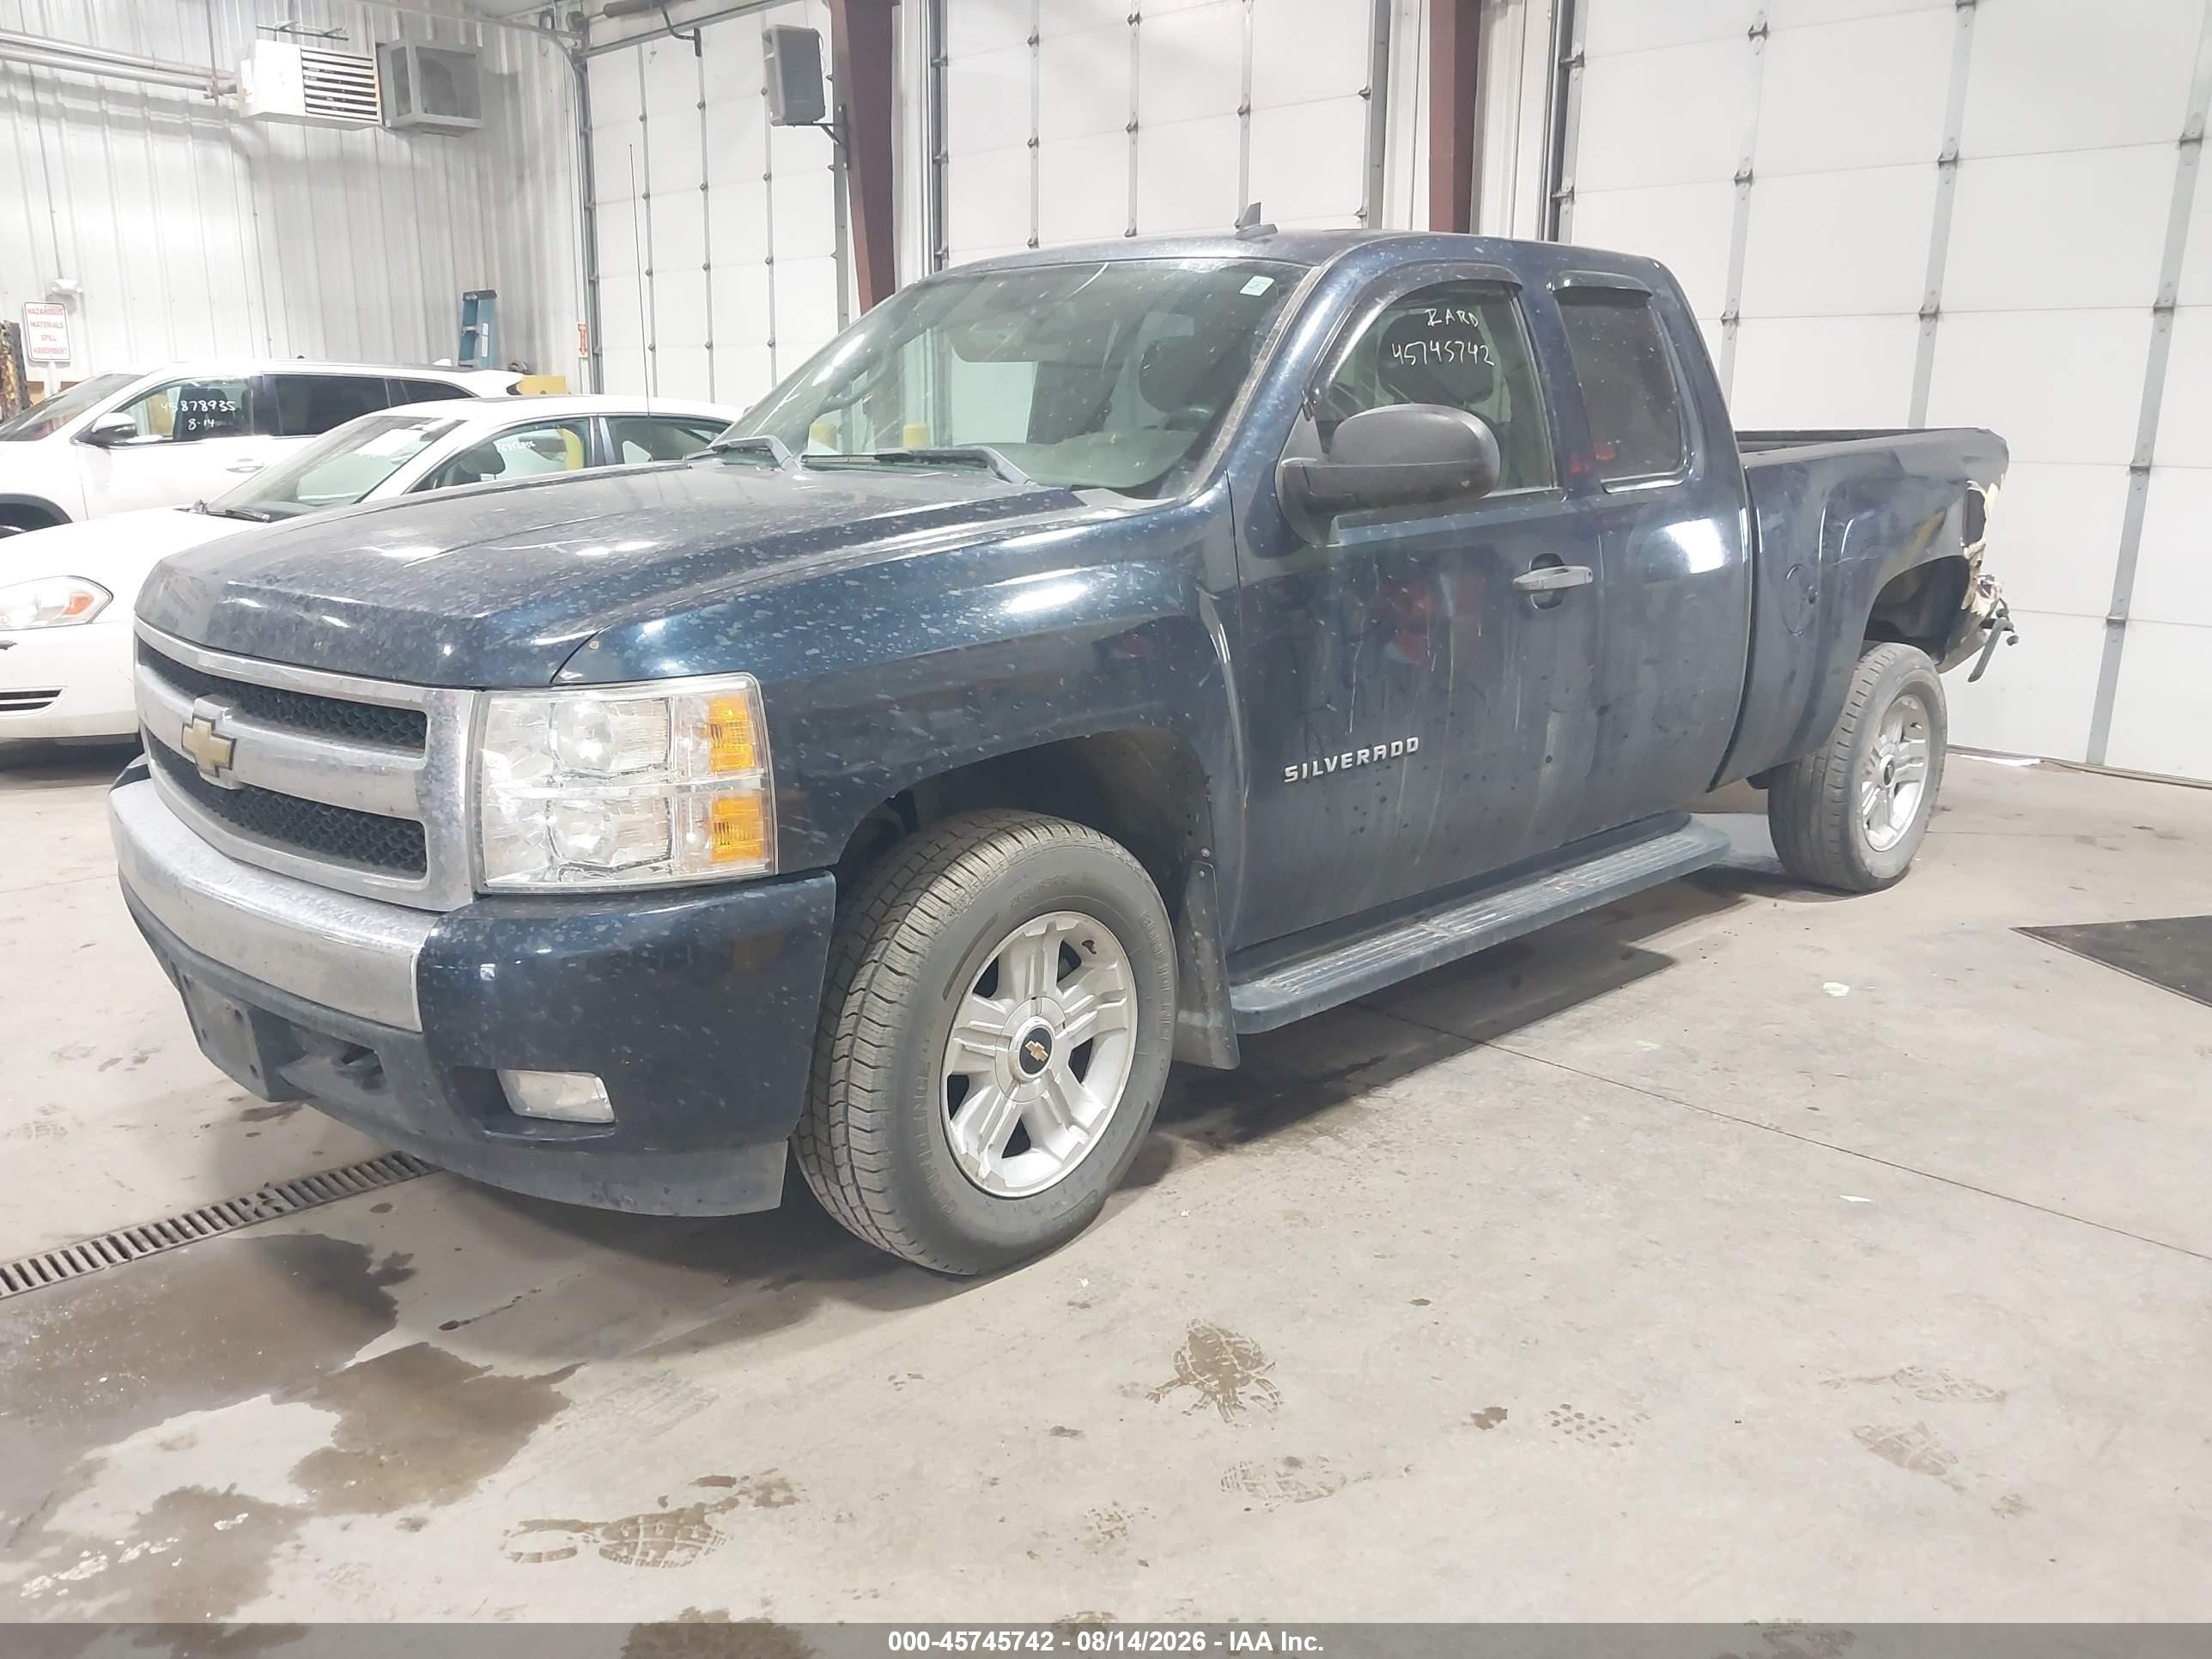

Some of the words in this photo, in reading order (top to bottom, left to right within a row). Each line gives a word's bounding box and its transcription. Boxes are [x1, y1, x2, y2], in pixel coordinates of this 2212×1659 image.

[1392, 339, 1495, 366] 45745742
[187, 418, 216, 432] 8-14
[1284, 736, 1419, 783] SILVERADO
